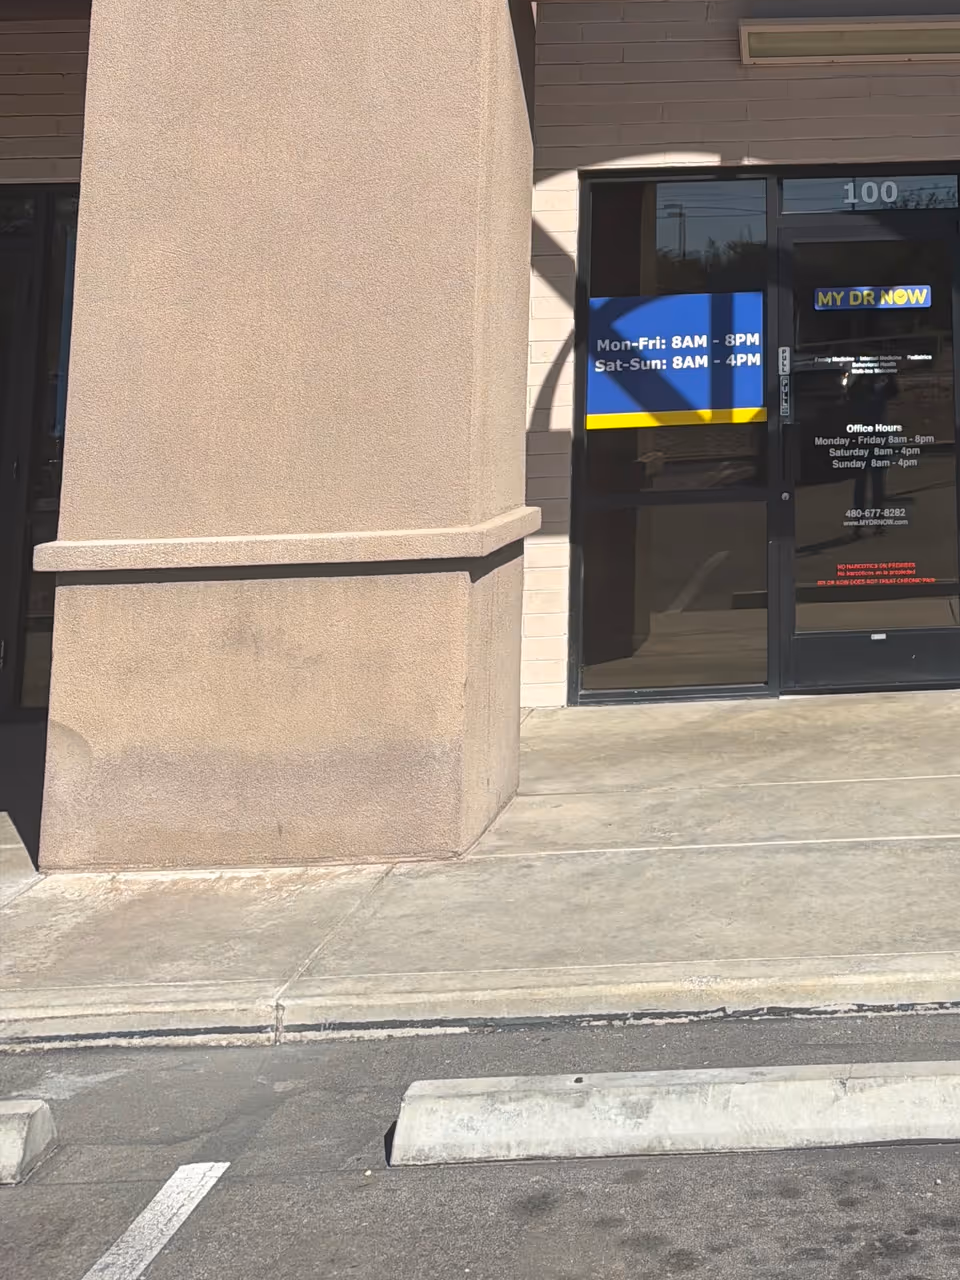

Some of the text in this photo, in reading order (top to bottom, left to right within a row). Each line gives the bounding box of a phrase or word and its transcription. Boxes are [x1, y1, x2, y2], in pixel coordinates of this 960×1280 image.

[843, 181, 897, 203] 100
[818, 289, 927, 306] MY DR NOW
[597, 336, 666, 351] Mon-Fri:
[671, 335, 707, 349] 8AM
[725, 333, 759, 347] 8PM
[595, 358, 666, 372] Sat-Sun:
[672, 355, 708, 369] 8AM
[726, 353, 761, 367] 4PM
[846, 423, 903, 434] Office Hours
[814, 436, 850, 447] Monday
[857, 435, 887, 446] Friday
[888, 435, 908, 444] 8am
[914, 434, 935, 445] 8pm
[829, 447, 870, 458] Saturday
[873, 447, 893, 456] 8am
[900, 446, 921, 457] 4pm
[832, 459, 867, 469] Sunday
[870, 458, 890, 467] 8am
[898, 458, 918, 468] 4pm
[845, 508, 906, 518] 480-677-8282
